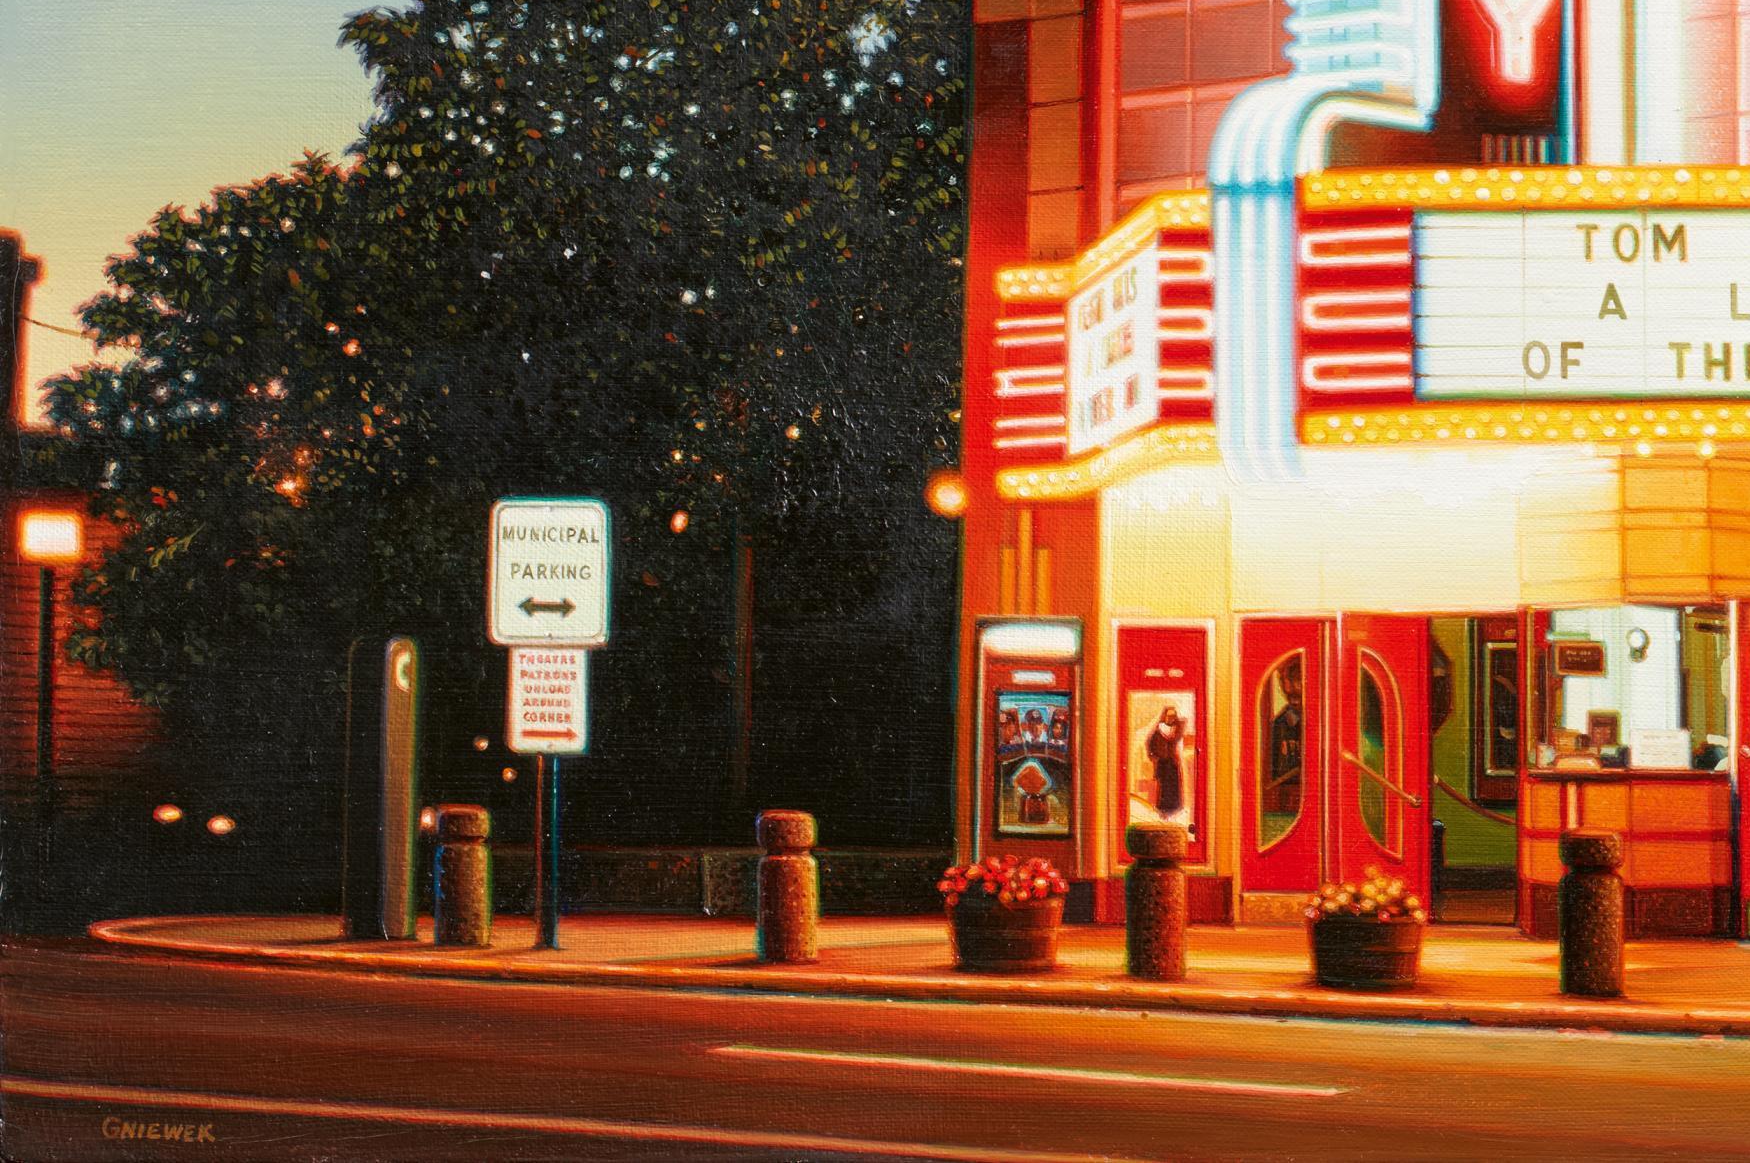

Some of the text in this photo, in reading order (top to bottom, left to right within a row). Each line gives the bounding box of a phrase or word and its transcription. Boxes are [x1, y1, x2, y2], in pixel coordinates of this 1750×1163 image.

[1575, 222, 1688, 263] TOM
[1598, 282, 1628, 320] A
[1521, 340, 1585, 381] OF
[502, 525, 600, 544] MUNICIPAL
[510, 562, 592, 581] PARKING
[523, 711, 572, 724] CORNER
[102, 1115, 216, 1143] GNIEWEK
